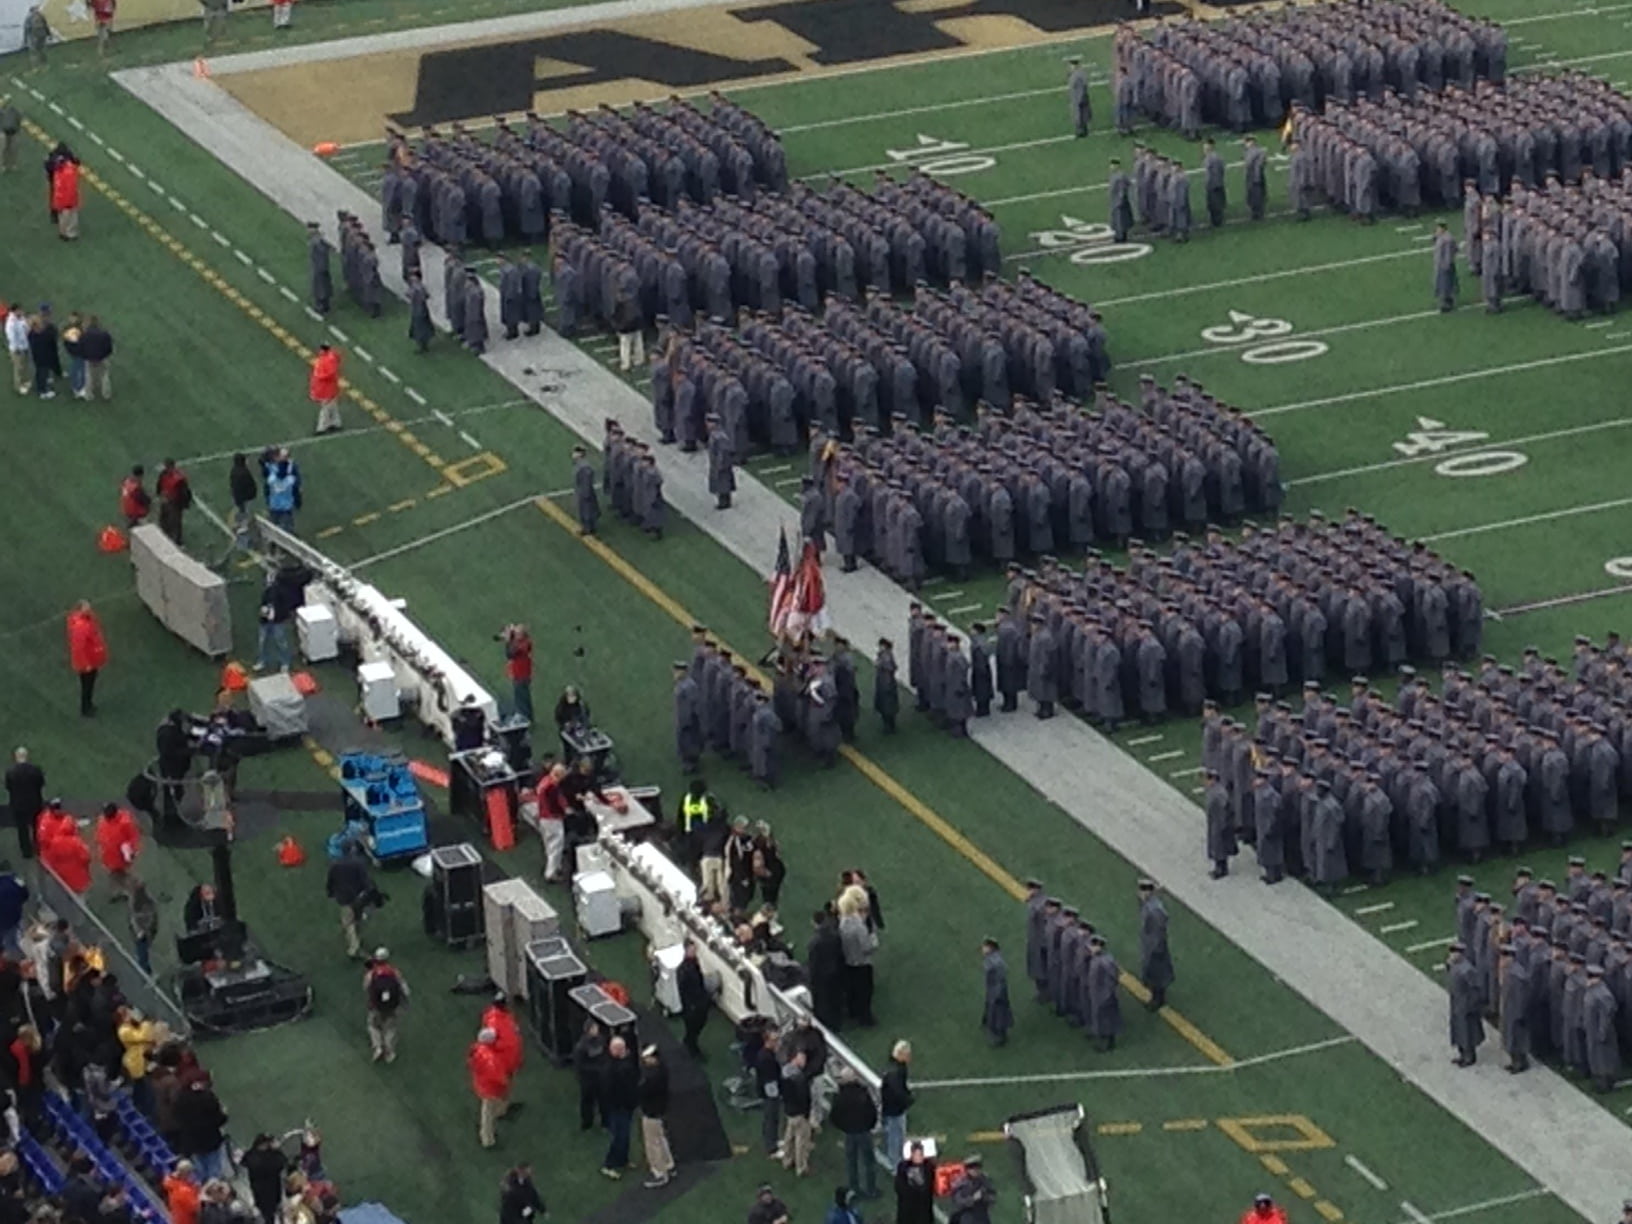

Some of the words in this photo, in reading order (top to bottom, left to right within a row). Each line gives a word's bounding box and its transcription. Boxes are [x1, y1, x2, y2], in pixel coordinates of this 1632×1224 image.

[886, 139, 997, 175] 10
[1031, 223, 1154, 266] 20
[1201, 317, 1329, 366] 30
[1392, 429, 1529, 478] 40
